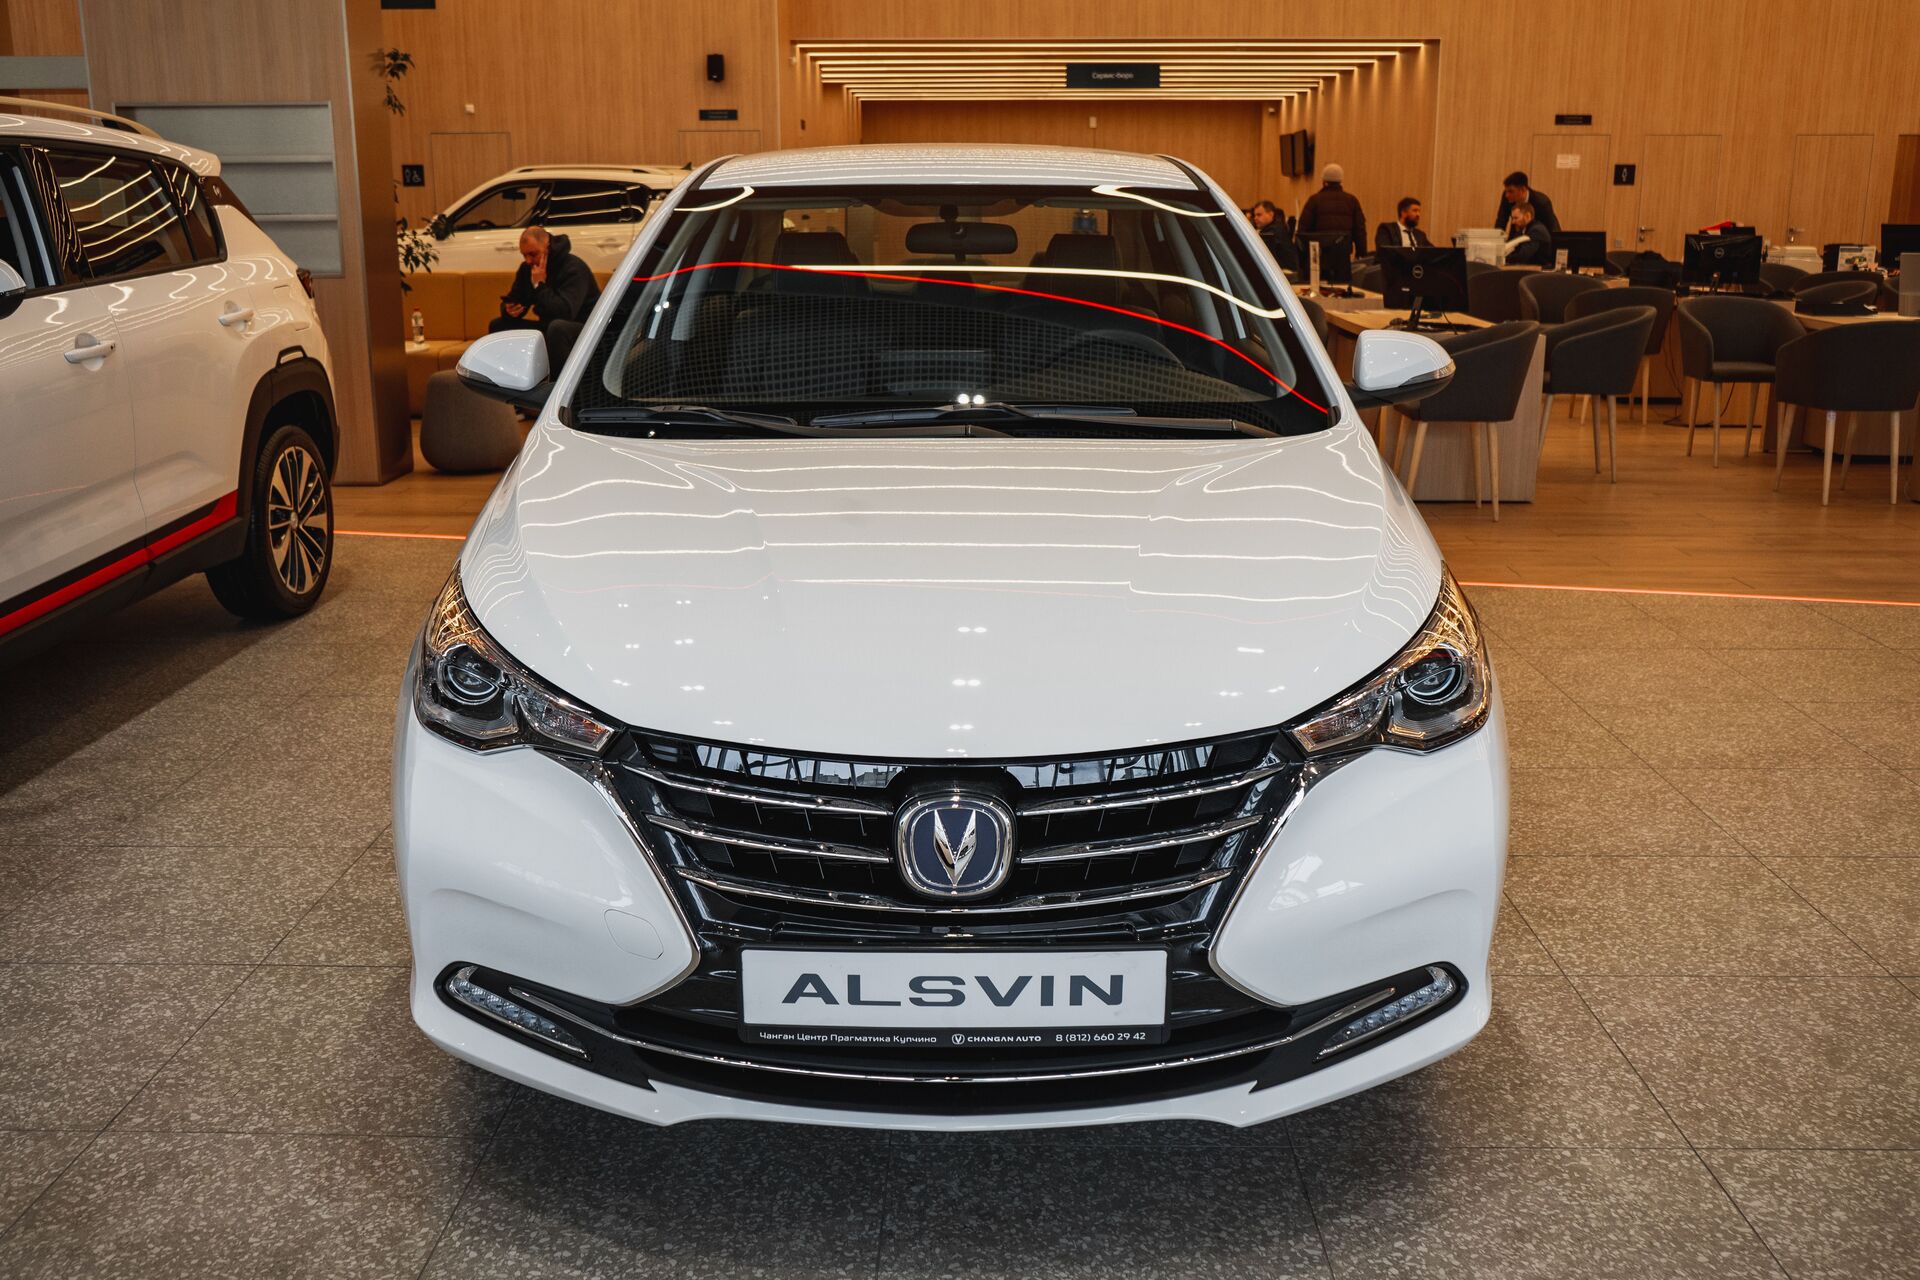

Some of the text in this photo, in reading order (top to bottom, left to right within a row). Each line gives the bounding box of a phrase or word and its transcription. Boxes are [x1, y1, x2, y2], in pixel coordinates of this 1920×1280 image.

[781, 973, 1124, 1007] ALSVIN
[759, 1032, 937, 1044] Чанган Центр Прагматика Купчино
[1055, 1032, 1146, 1043] 8 (812) 660 29 42
